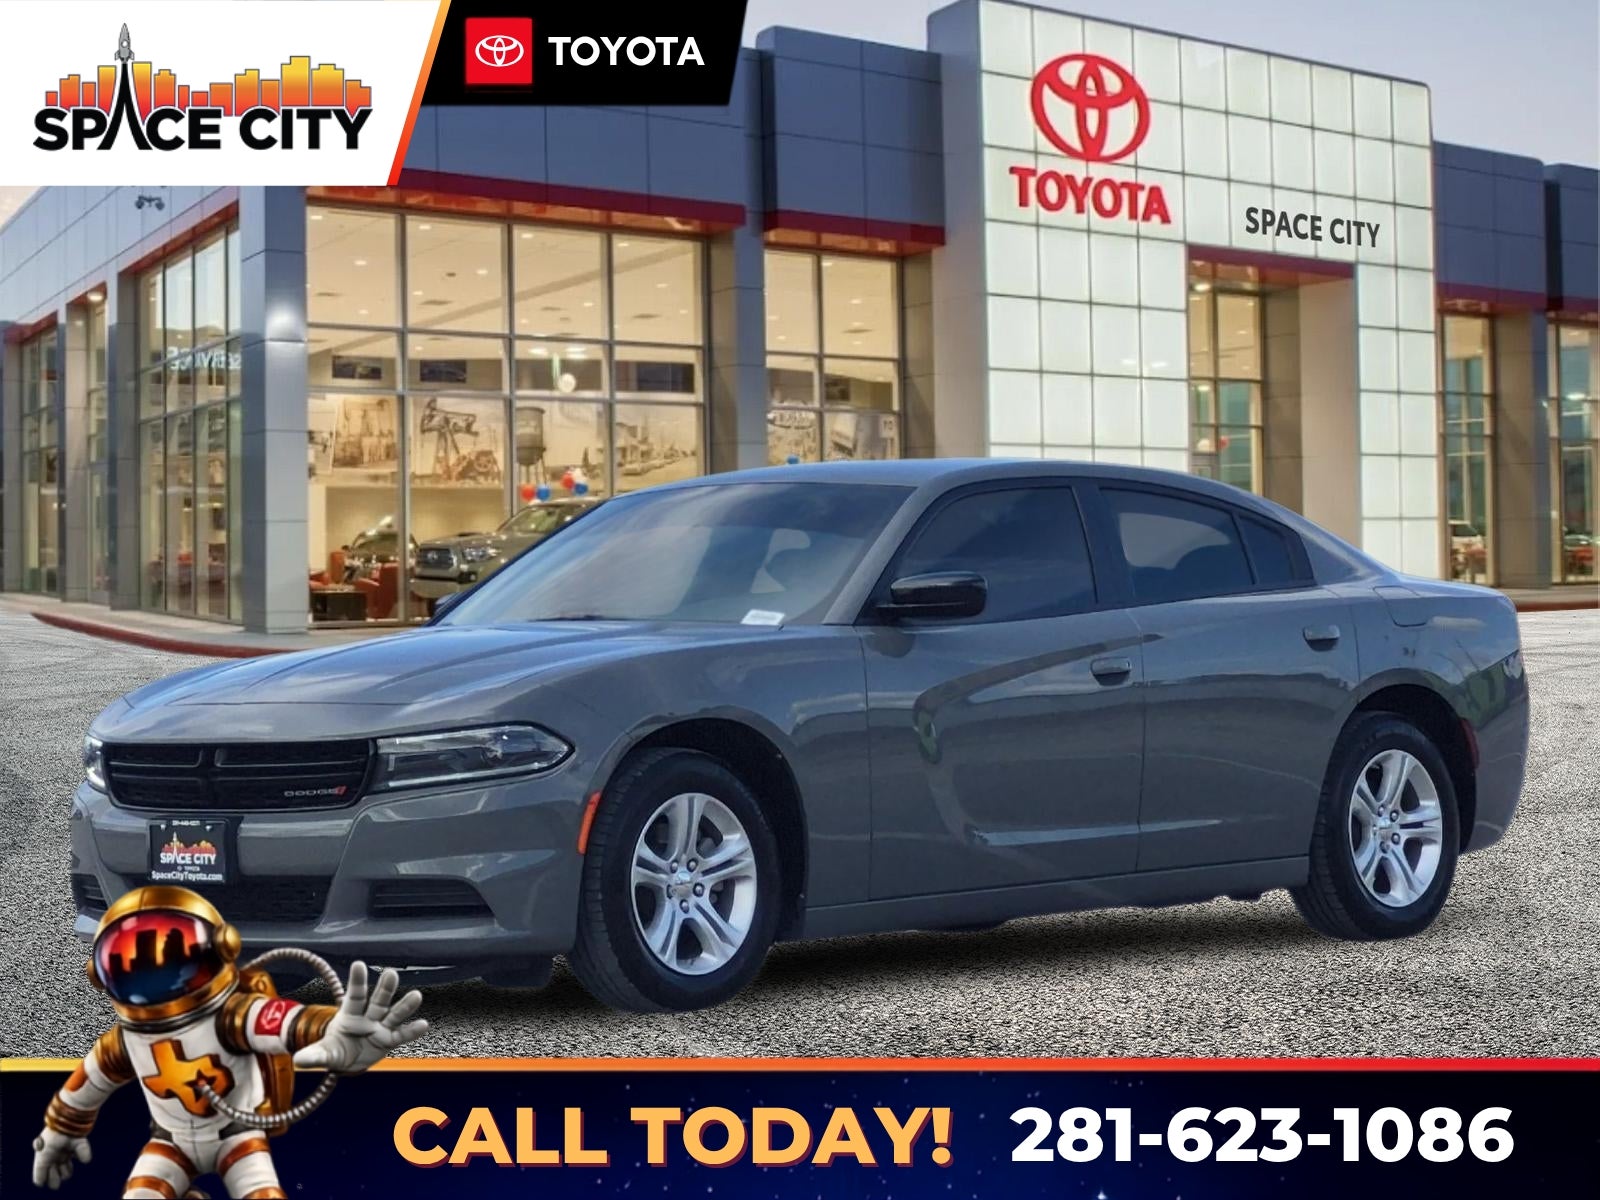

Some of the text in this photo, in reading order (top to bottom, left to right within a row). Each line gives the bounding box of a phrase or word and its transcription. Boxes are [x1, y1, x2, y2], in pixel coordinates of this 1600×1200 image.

[1009, 166, 1171, 225] TOYOTA
[1245, 206, 1381, 248] SPACE CITY
[283, 788, 337, 797] DODGE
[160, 852, 216, 865] SPACE CITY
[151, 870, 223, 882] SpaceCityToyota.com
